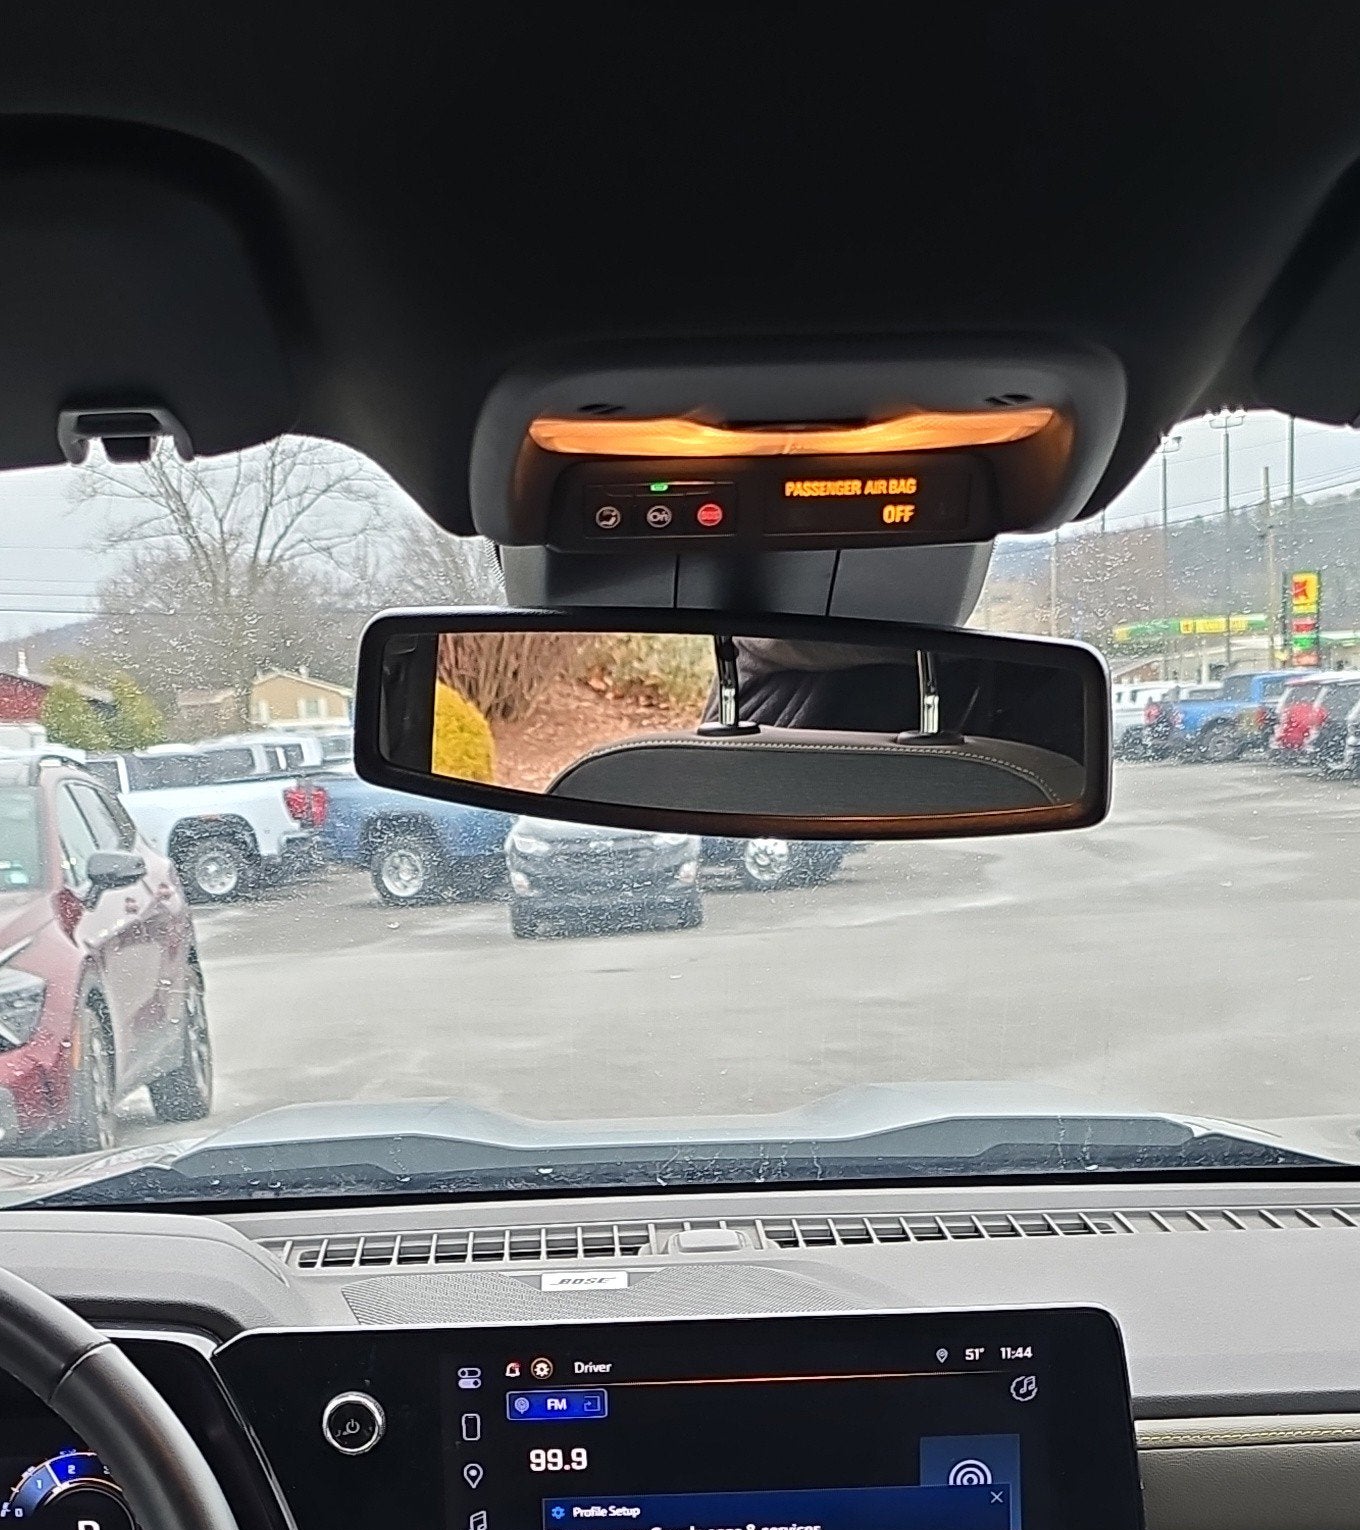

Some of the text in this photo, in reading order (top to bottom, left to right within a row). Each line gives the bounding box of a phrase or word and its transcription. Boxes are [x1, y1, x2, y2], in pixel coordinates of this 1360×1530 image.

[785, 480, 862, 496] PASSENGER
[882, 504, 915, 523] OFF
[549, 1275, 618, 1287] BOSE
[1000, 1346, 1033, 1359] 11:44
[574, 1361, 612, 1374] Driver
[547, 1398, 566, 1411] FM
[530, 1448, 588, 1471] 99.9
[573, 1505, 641, 1519] Profile Setup
